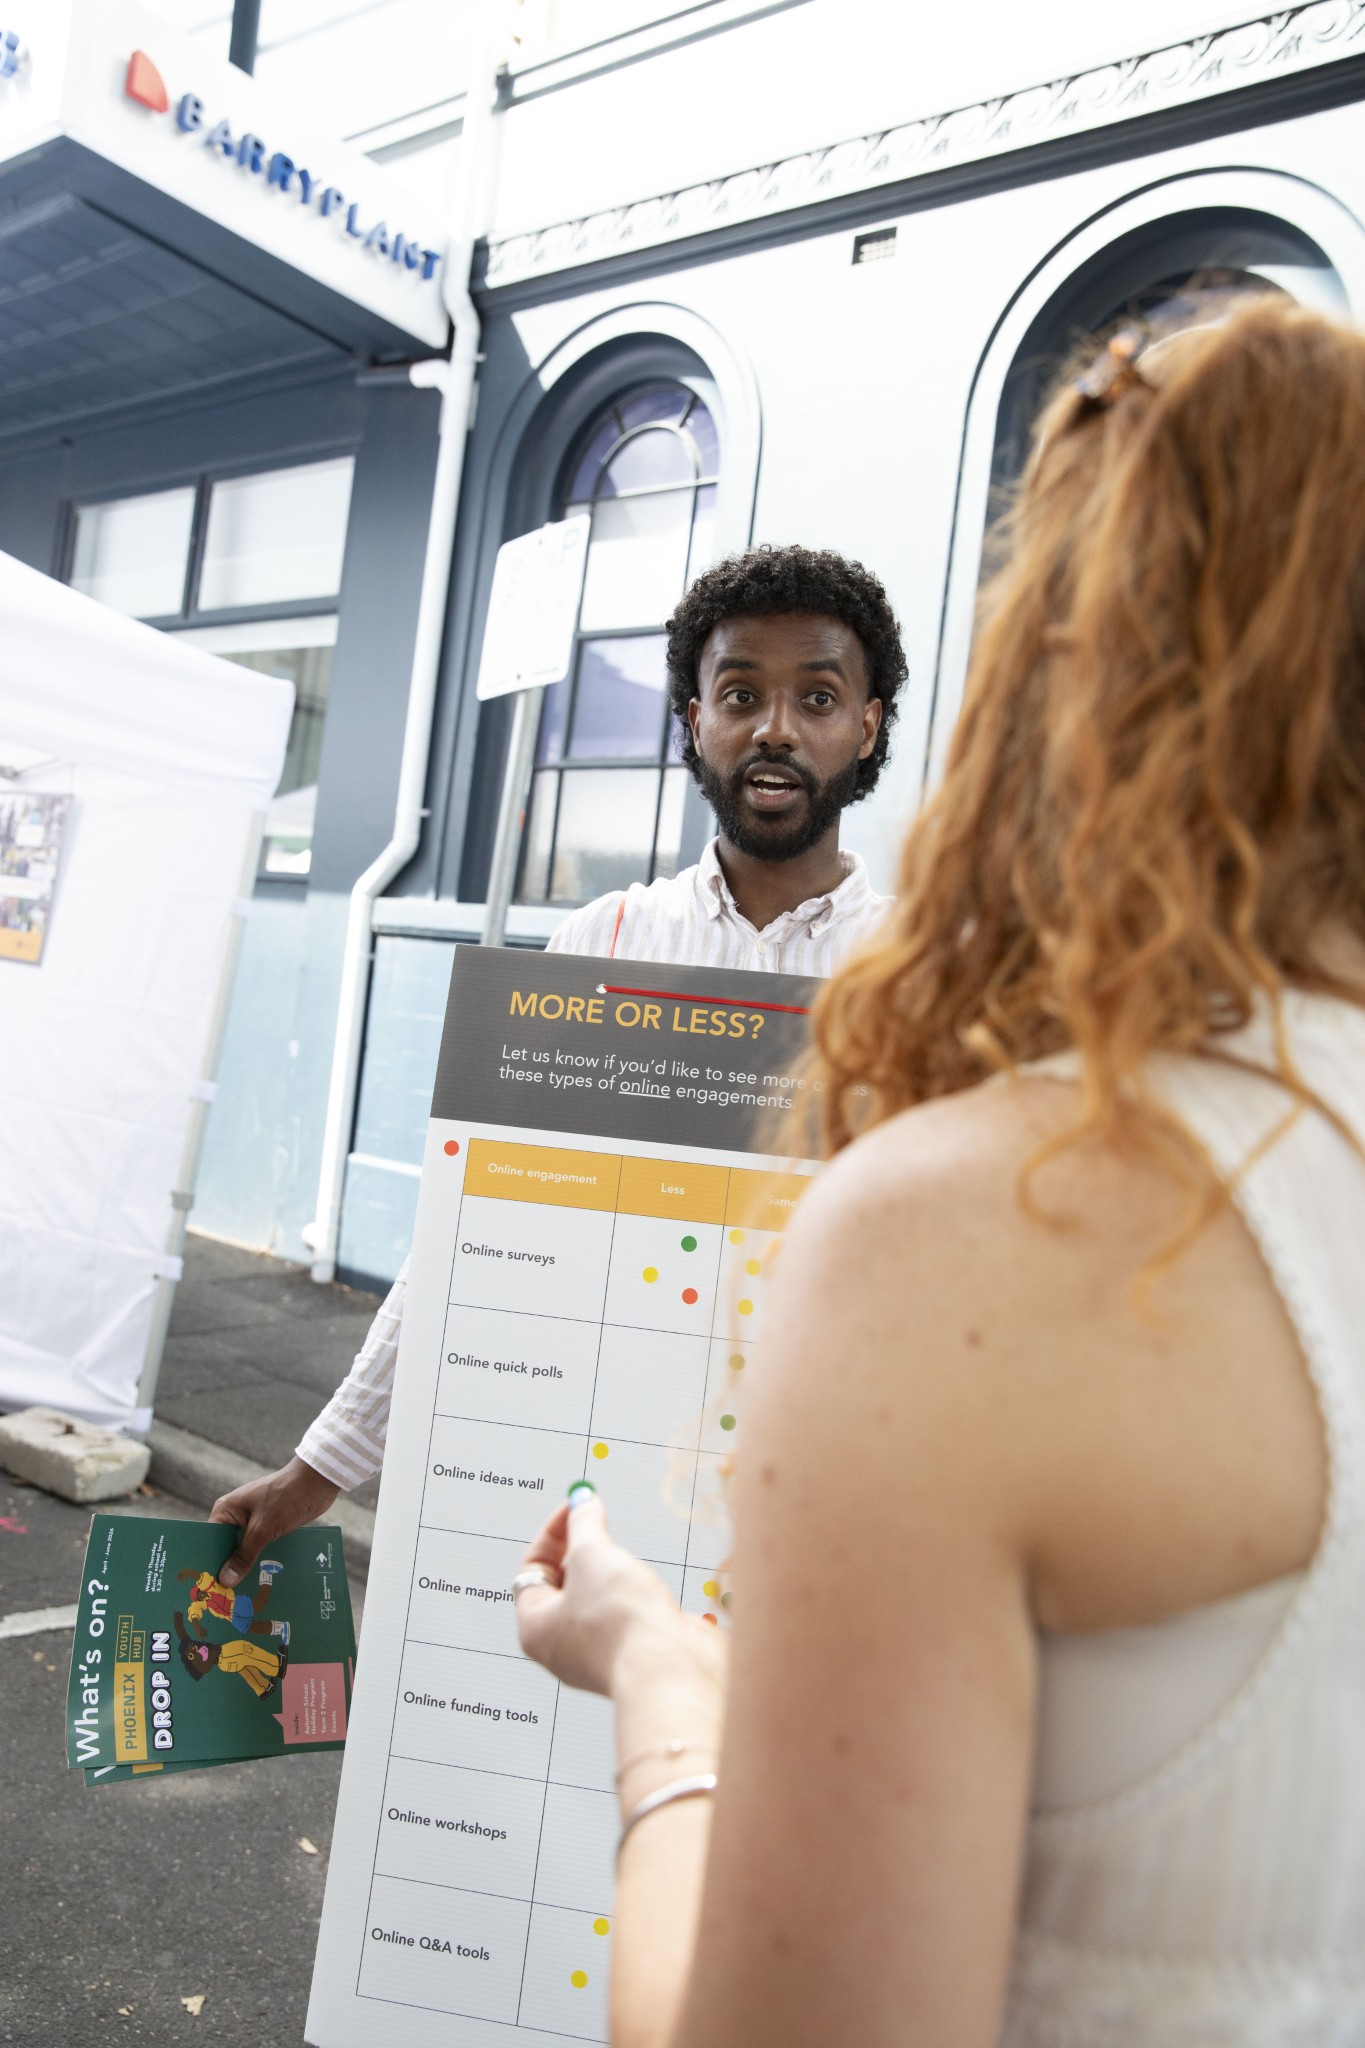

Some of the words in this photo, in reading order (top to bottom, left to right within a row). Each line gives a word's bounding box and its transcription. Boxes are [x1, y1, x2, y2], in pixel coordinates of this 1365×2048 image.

[509, 991, 605, 1024] MORE
[615, 1002, 661, 1030] OR
[672, 1006, 765, 1039] LESS?
[499, 1065, 543, 1083] these
[548, 1071, 592, 1090] types
[598, 1074, 616, 1090] of
[619, 1079, 671, 1098] online
[502, 1044, 527, 1061] Let
[532, 1050, 550, 1063] us
[555, 1049, 599, 1069] know
[604, 1055, 615, 1070] if
[671, 1061, 700, 1078] like
[705, 1066, 723, 1081] to
[728, 1071, 757, 1085] see
[763, 1075, 807, 1091] more
[488, 1163, 524, 1177] Online
[527, 1169, 598, 1186] engagement
[661, 1183, 685, 1195] Less
[462, 1242, 503, 1258] Online
[507, 1250, 555, 1266] surveys
[447, 1352, 490, 1369] Online
[493, 1358, 528, 1375] quick
[532, 1364, 564, 1380] polls
[433, 1464, 476, 1481] Online
[479, 1470, 514, 1486] ideas
[517, 1476, 545, 1491] wall
[148, 1543, 158, 1569] Thursday
[145, 1570, 153, 1592] Weekly
[418, 1576, 461, 1593] Online
[465, 1586, 517, 1606] mappin
[88, 1579, 110, 1637] on?
[119, 1621, 130, 1658] YOUTH
[132, 1636, 141, 1658] HUB
[151, 1631, 170, 1662] IN
[123, 1673, 138, 1750] PHOENIX
[151, 1670, 174, 1750] DROP
[403, 1691, 447, 1709] Online
[450, 1698, 501, 1721] funding
[506, 1708, 539, 1724] tools
[387, 1808, 431, 1826] Online
[435, 1818, 507, 1841] workshops
[371, 1928, 415, 1947] Online
[419, 1936, 452, 1955] Q&A
[456, 1944, 490, 1961] tools
